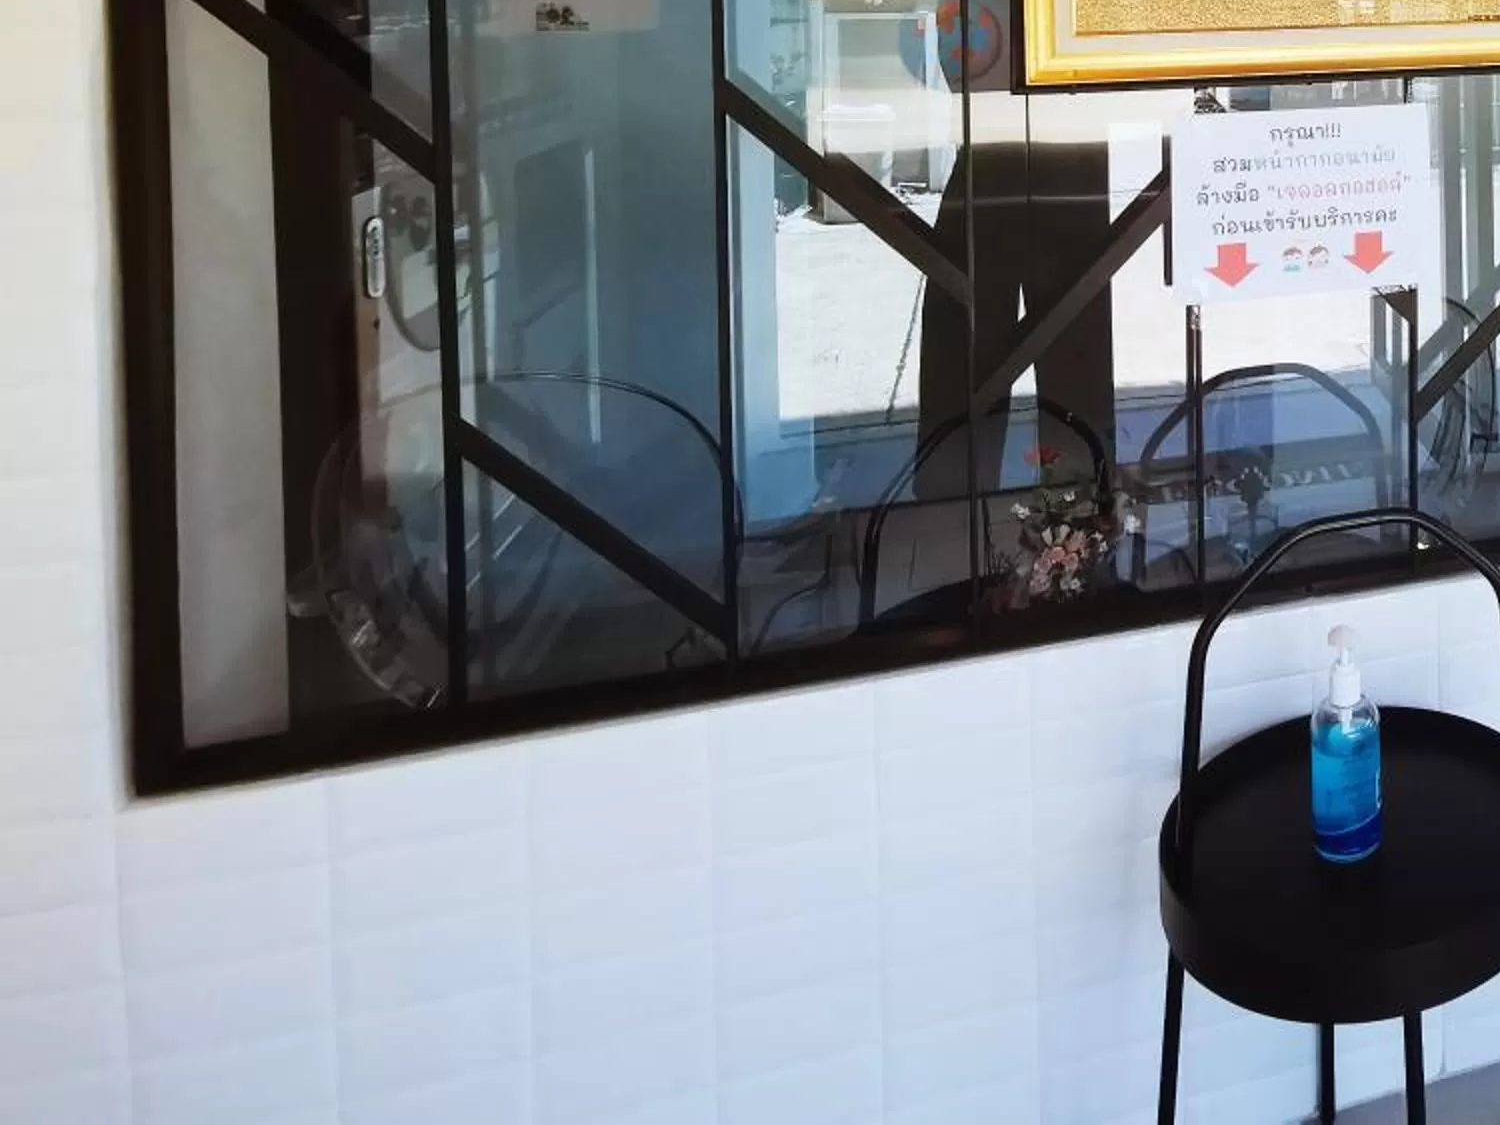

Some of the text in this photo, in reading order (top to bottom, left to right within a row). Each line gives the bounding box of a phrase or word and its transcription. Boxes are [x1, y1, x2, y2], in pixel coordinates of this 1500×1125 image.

[1269, 123, 1342, 148] กรุณา!!!
[1197, 181, 1260, 207] ล้างมือ
